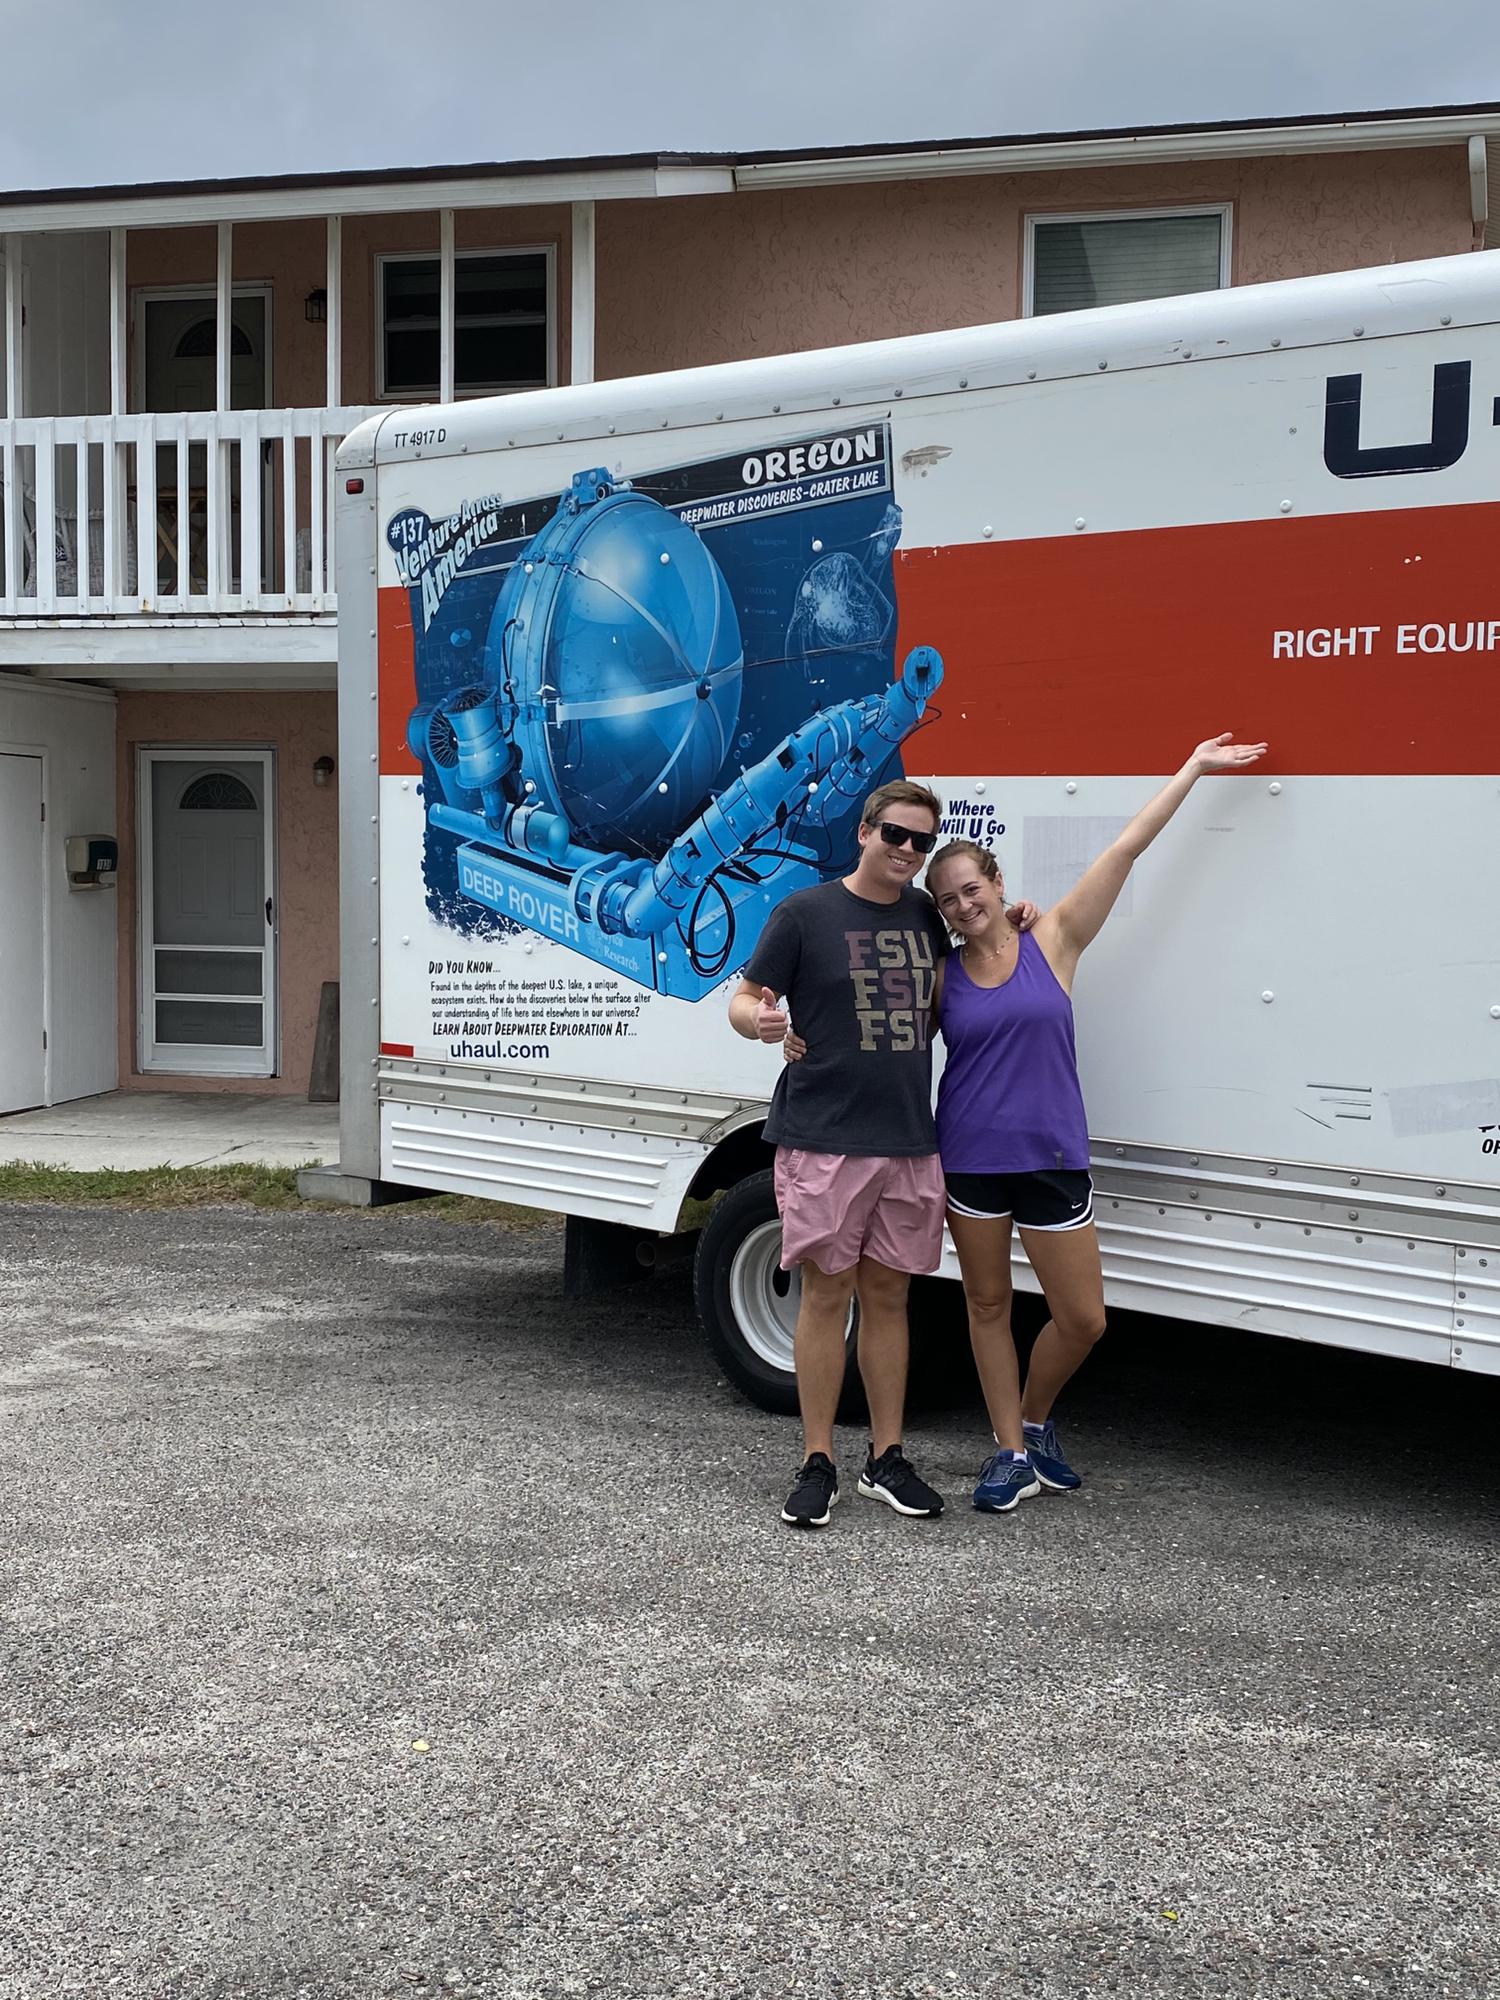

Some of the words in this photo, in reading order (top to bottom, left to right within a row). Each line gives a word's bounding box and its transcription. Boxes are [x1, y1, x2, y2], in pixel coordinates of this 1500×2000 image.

[1323, 360, 1500, 480] U
[394, 433, 408, 448] TT
[410, 430, 435, 446] 4917
[437, 428, 447, 443] D
[742, 430, 876, 485] OREGON
[680, 501, 735, 523] DEEPWATER
[852, 470, 879, 489] LAKE
[390, 516, 424, 545] #137
[394, 515, 460, 588] Venture
[460, 493, 503, 522] Across
[421, 511, 499, 634] America
[1272, 625, 1381, 659] RIGHT
[948, 800, 995, 816] Where
[938, 819, 966, 835] Will
[968, 818, 983, 839] U
[986, 819, 1006, 836] Go
[463, 865, 504, 903] DEEP
[508, 884, 580, 943] ROVER
[844, 930, 934, 969] FSU
[430, 981, 451, 991] Found
[453, 981, 460, 991] in
[461, 980, 472, 991] the
[474, 980, 497, 992] depths
[498, 980, 506, 990] of
[508, 979, 519, 990] the
[521, 980, 547, 992] deepest
[549, 979, 566, 990] U.S.
[568, 979, 585, 991] lake,
[587, 981, 592, 990] a
[594, 980, 618, 991] unique
[431, 995, 465, 1006] ecosystem
[466, 995, 488, 1005] exists.
[489, 993, 504, 1004] How
[506, 993, 515, 1004] do
[516, 993, 527, 1004] the
[529, 993, 567, 1004] discoveries
[568, 992, 589, 1003] below
[591, 992, 603, 1003] the
[605, 992, 632, 1003] surface
[634, 992, 652, 1003] alter
[849, 969, 937, 1009] FSU
[431, 1010, 443, 1018] our
[444, 1008, 490, 1020] understanding
[491, 1007, 500, 1018] of
[501, 1007, 512, 1018] life
[514, 1007, 530, 1018] here
[531, 1007, 544, 1018] and
[546, 1007, 580, 1018] elsewhere
[582, 1007, 589, 1018] in
[591, 1009, 604, 1018] our
[605, 1006, 640, 1018] universe?
[432, 1022, 460, 1036] LEARN
[462, 1021, 493, 1036] ABOUT
[494, 1021, 547, 1036] DEEPWATER
[549, 1021, 613, 1036] EXPLORATION
[856, 1010, 931, 1051] FSU
[450, 1040, 550, 1059] uhaul.com
